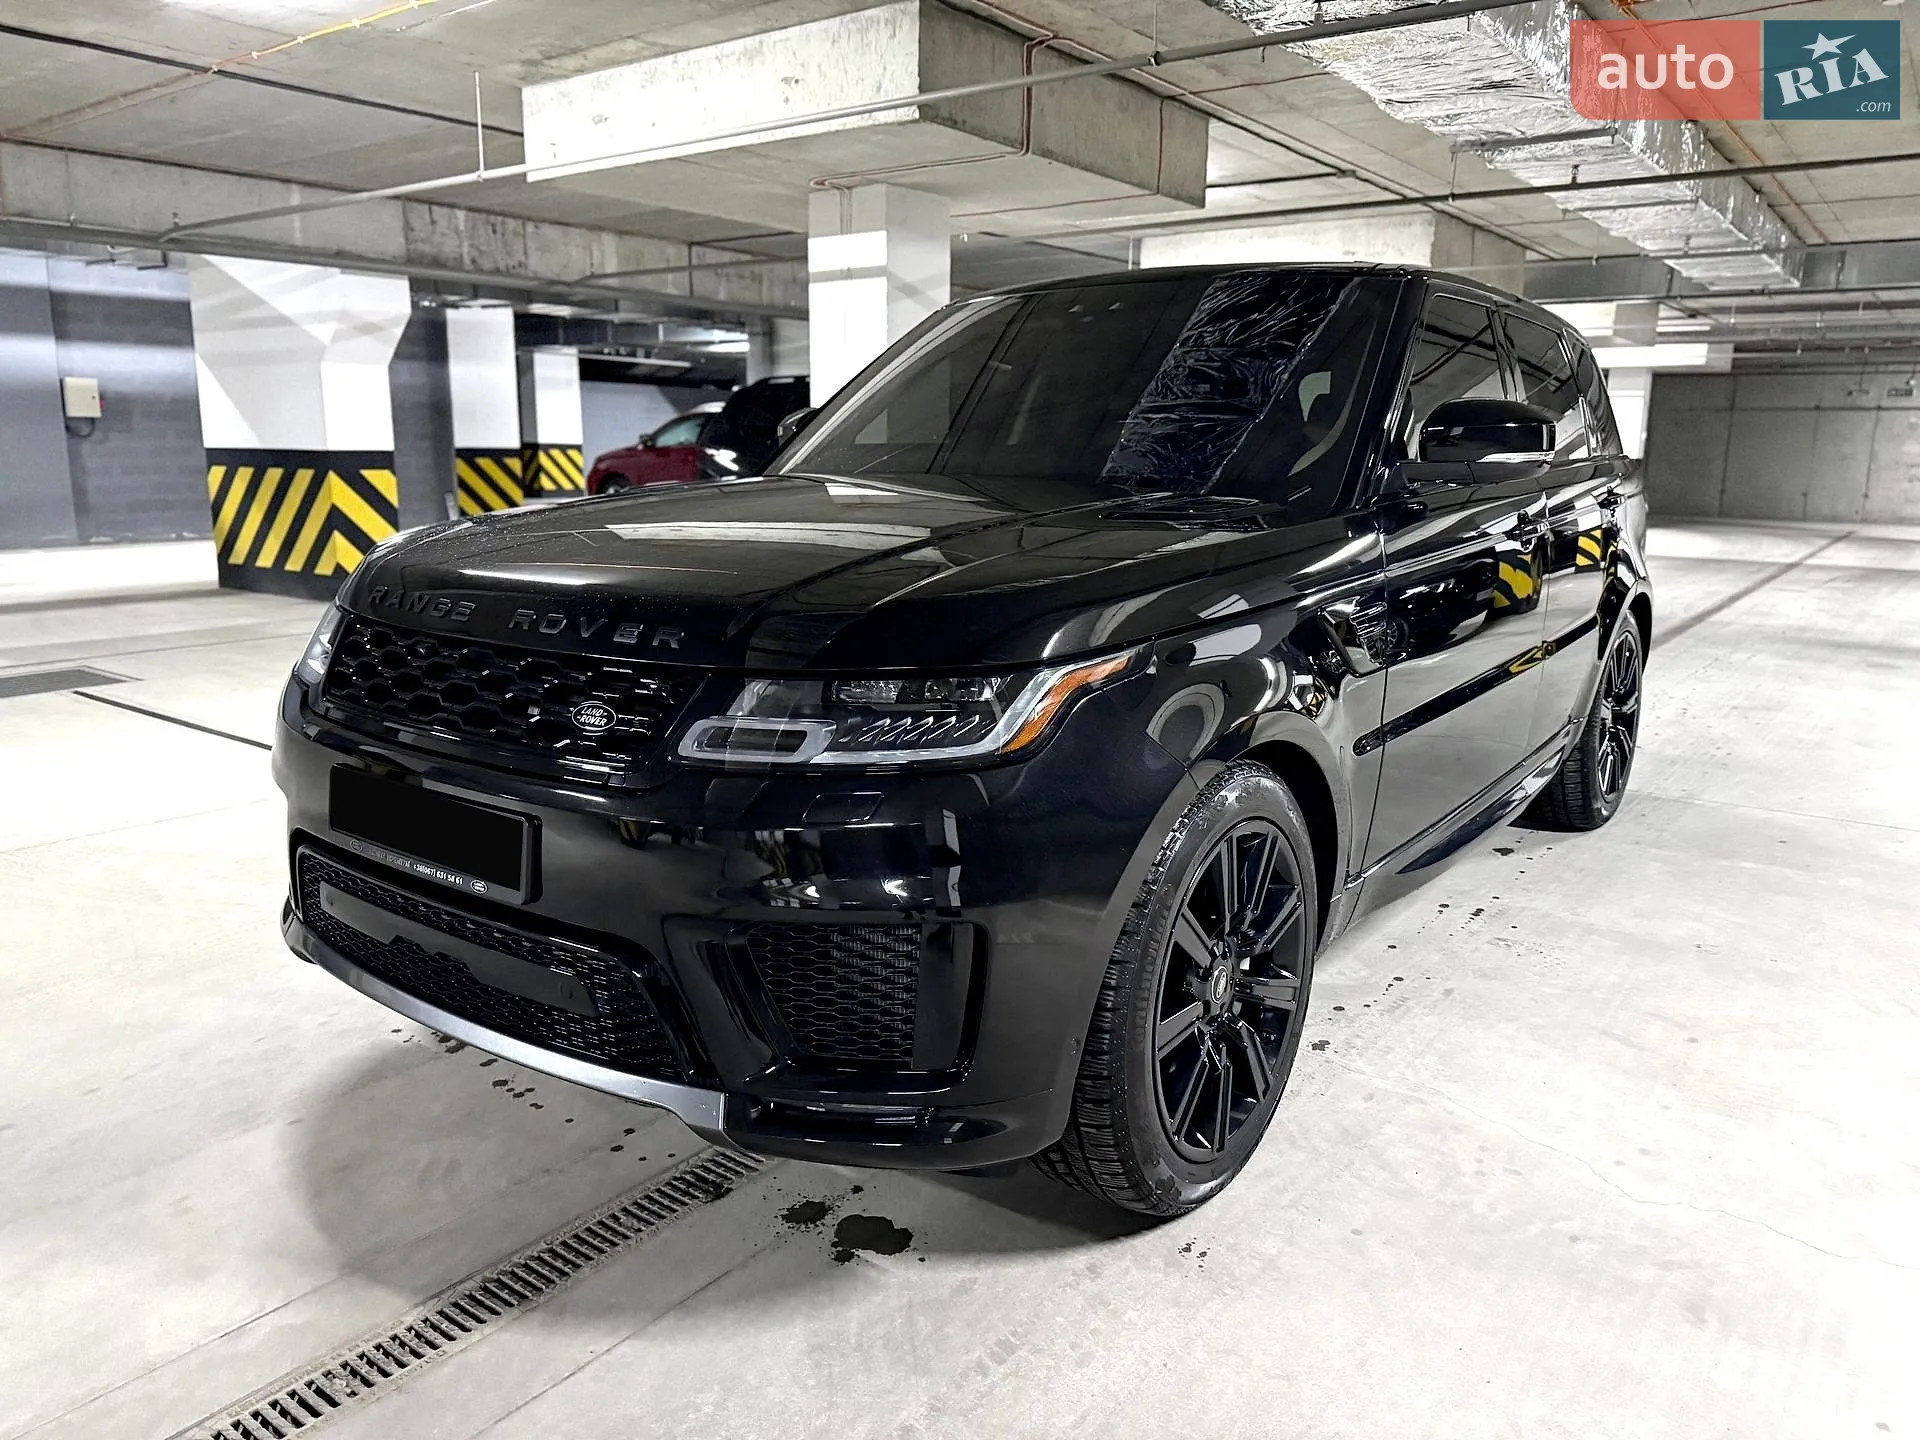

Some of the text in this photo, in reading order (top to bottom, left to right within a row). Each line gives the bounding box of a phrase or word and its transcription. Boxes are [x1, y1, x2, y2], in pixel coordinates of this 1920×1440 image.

[368, 585, 686, 649] RANGE ROVER
[581, 706, 604, 717] LAND
[579, 714, 608, 727] ROVER
